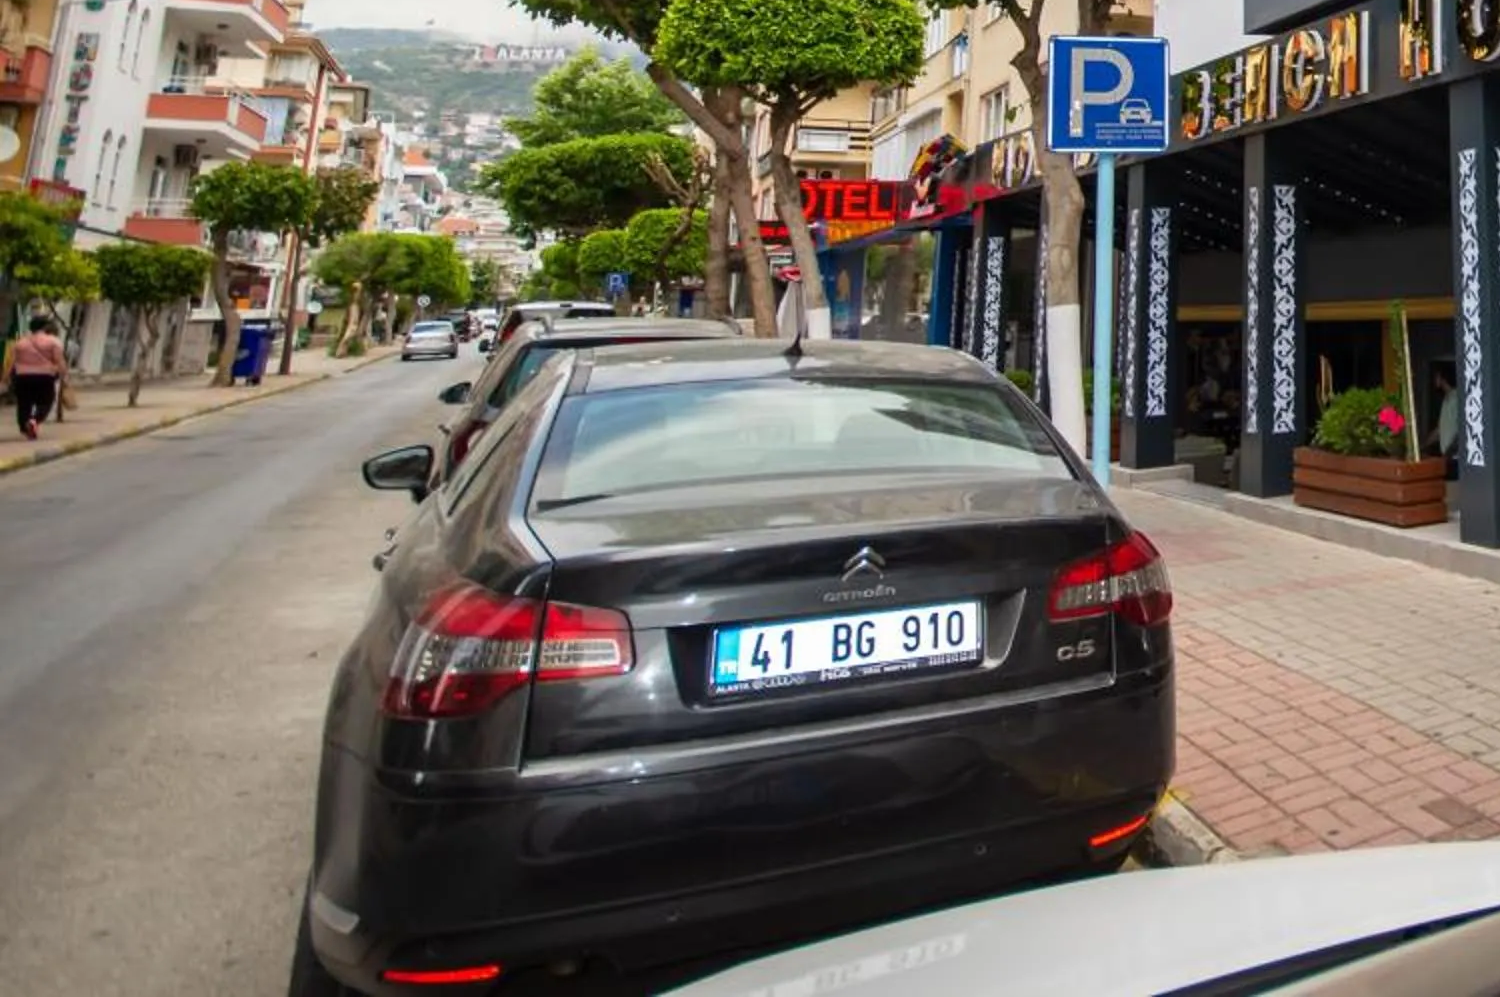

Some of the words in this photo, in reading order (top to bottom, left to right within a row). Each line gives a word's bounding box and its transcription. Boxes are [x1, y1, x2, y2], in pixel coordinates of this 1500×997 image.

[54, 33, 99, 183] HOTEL
[1069, 47, 1134, 137] P
[751, 629, 794, 673] 41
[831, 620, 876, 664] BG
[902, 610, 965, 652] 910
[1057, 639, 1096, 661] C5
